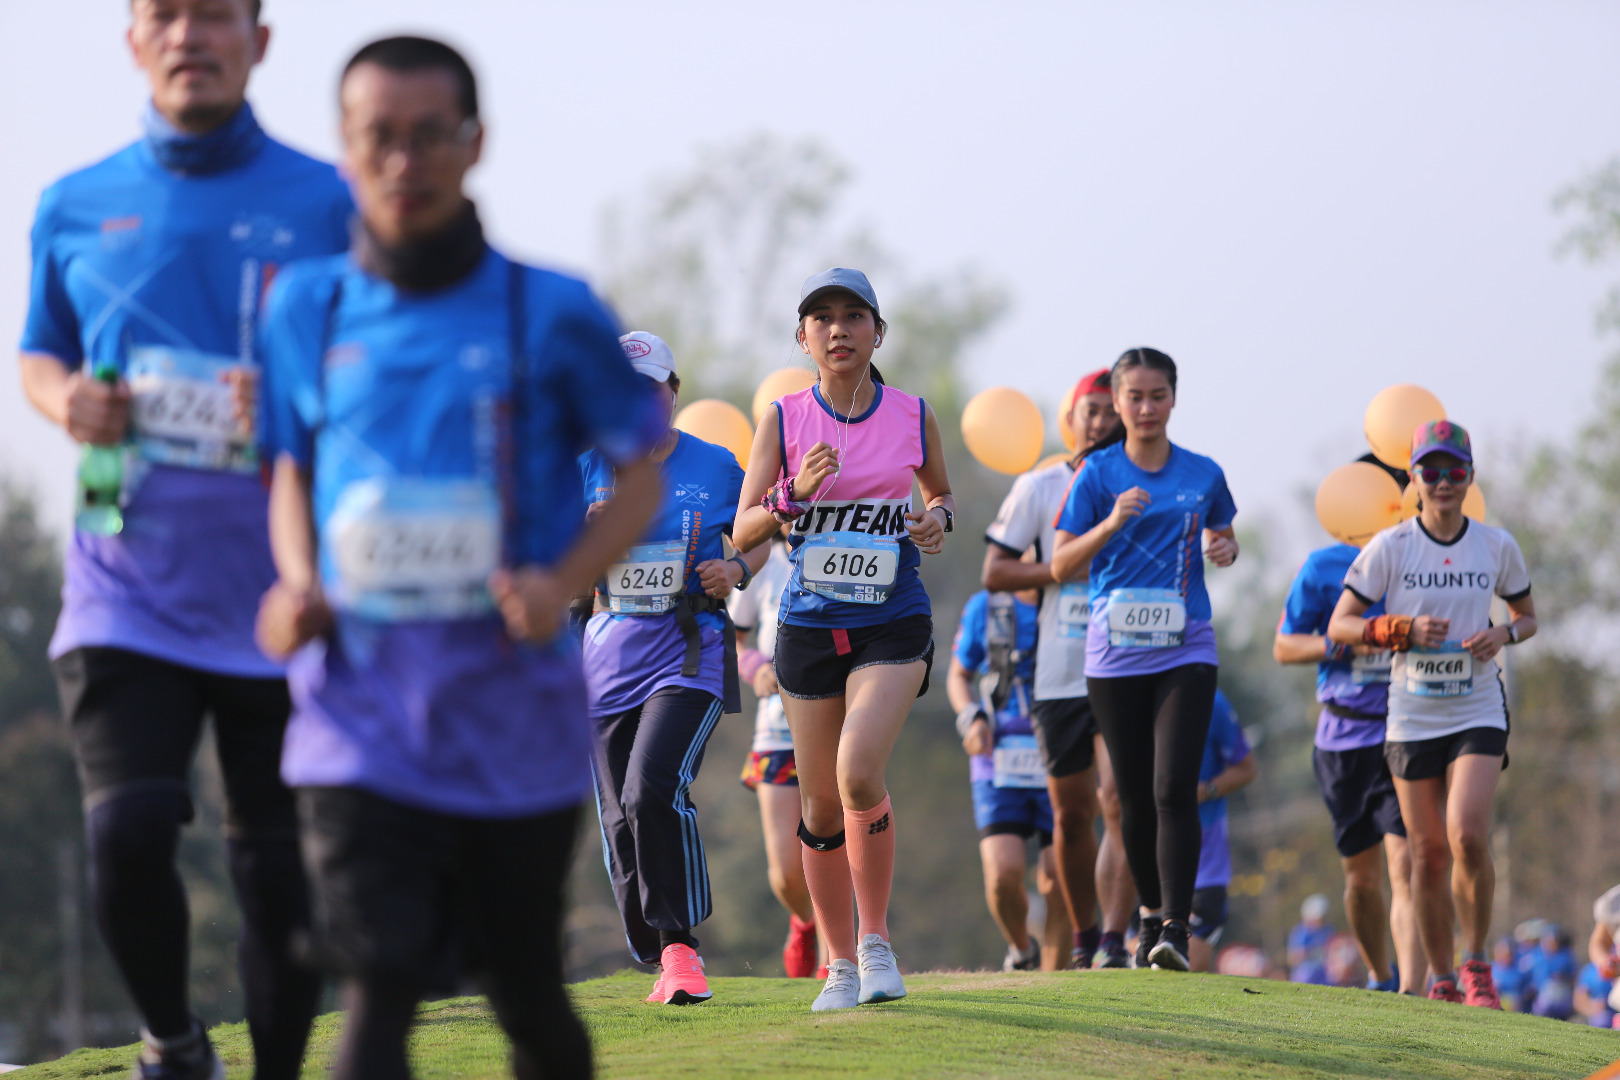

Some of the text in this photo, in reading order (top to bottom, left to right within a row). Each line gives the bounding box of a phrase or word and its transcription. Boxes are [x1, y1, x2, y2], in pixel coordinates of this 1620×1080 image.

[698, 491, 710, 500] XC
[681, 509, 690, 544] CROSS
[688, 510, 702, 552] SINGHA
[823, 552, 879, 578] 6106
[620, 566, 674, 589] 6248
[1403, 572, 1490, 590] SUUNTO
[1125, 607, 1171, 626] 6091
[1415, 658, 1464, 674] PACER
